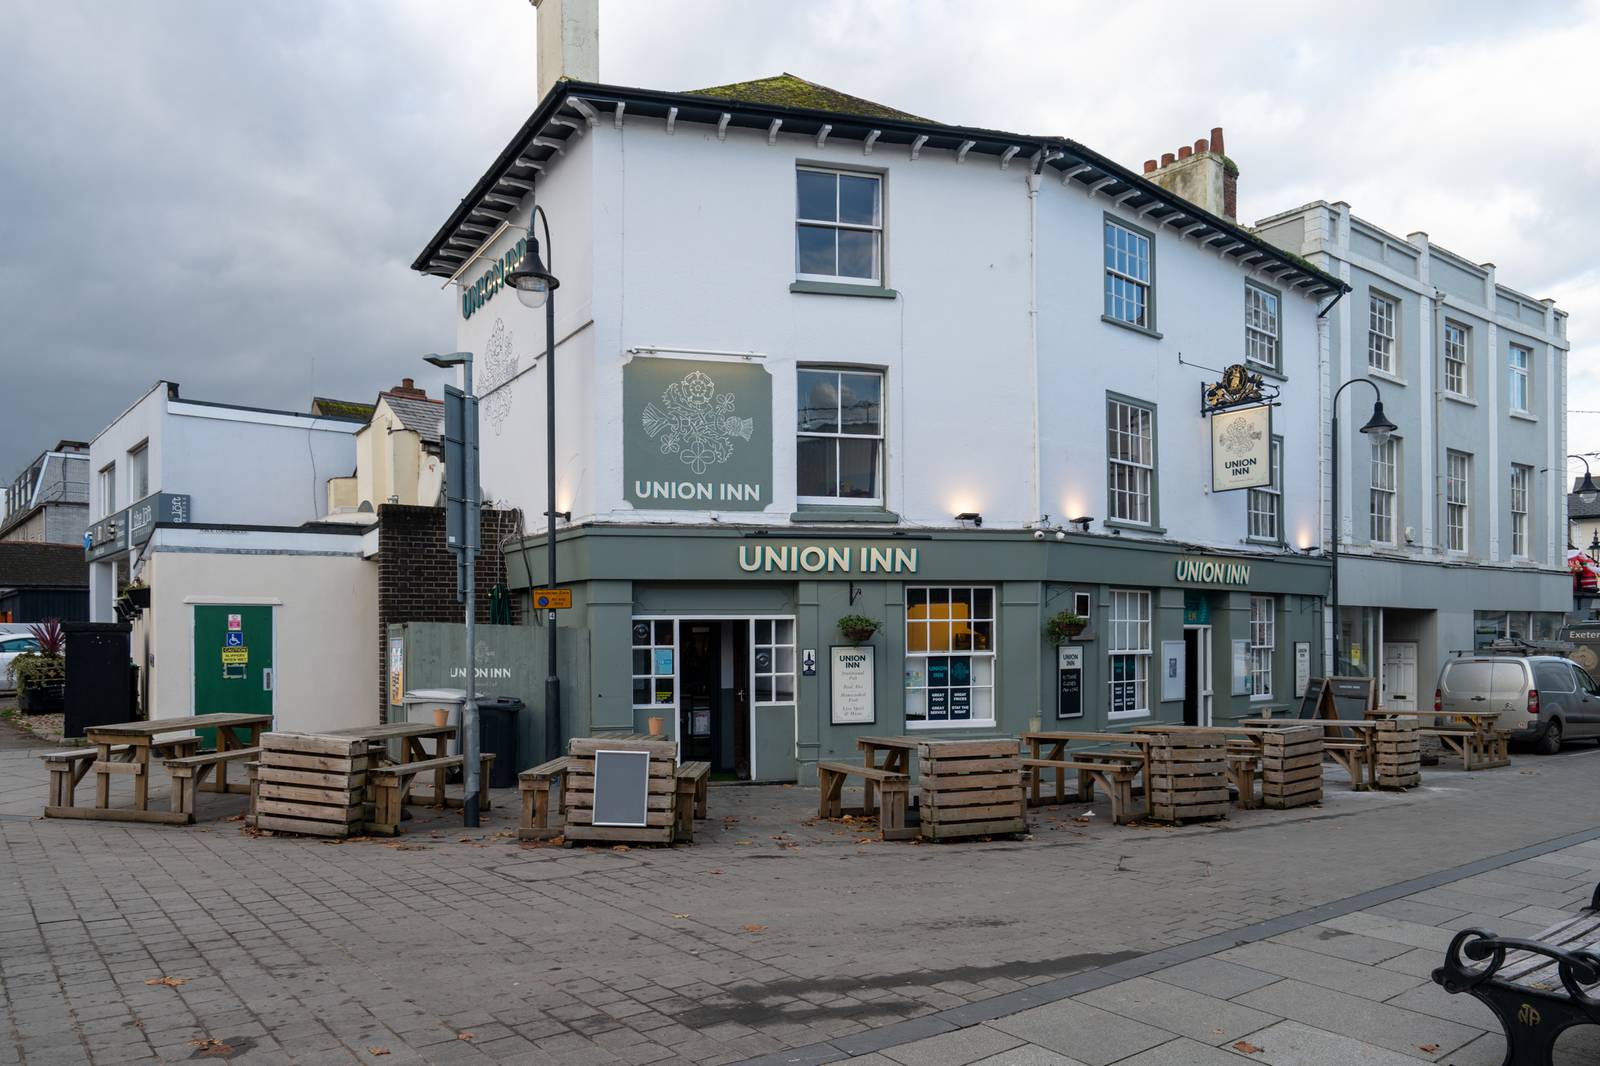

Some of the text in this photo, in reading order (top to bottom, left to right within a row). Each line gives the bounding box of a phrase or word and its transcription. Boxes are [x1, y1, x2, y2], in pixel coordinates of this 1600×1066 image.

[463, 257, 504, 319] UNION
[1225, 458, 1257, 469] UNION
[1232, 467, 1249, 476] INN
[635, 480, 760, 501] UNION INN
[739, 545, 917, 573] UNION INN
[1176, 560, 1250, 585] UNION INN
[1569, 631, 1600, 639] Exeter
[450, 667, 511, 678] UNON INN
